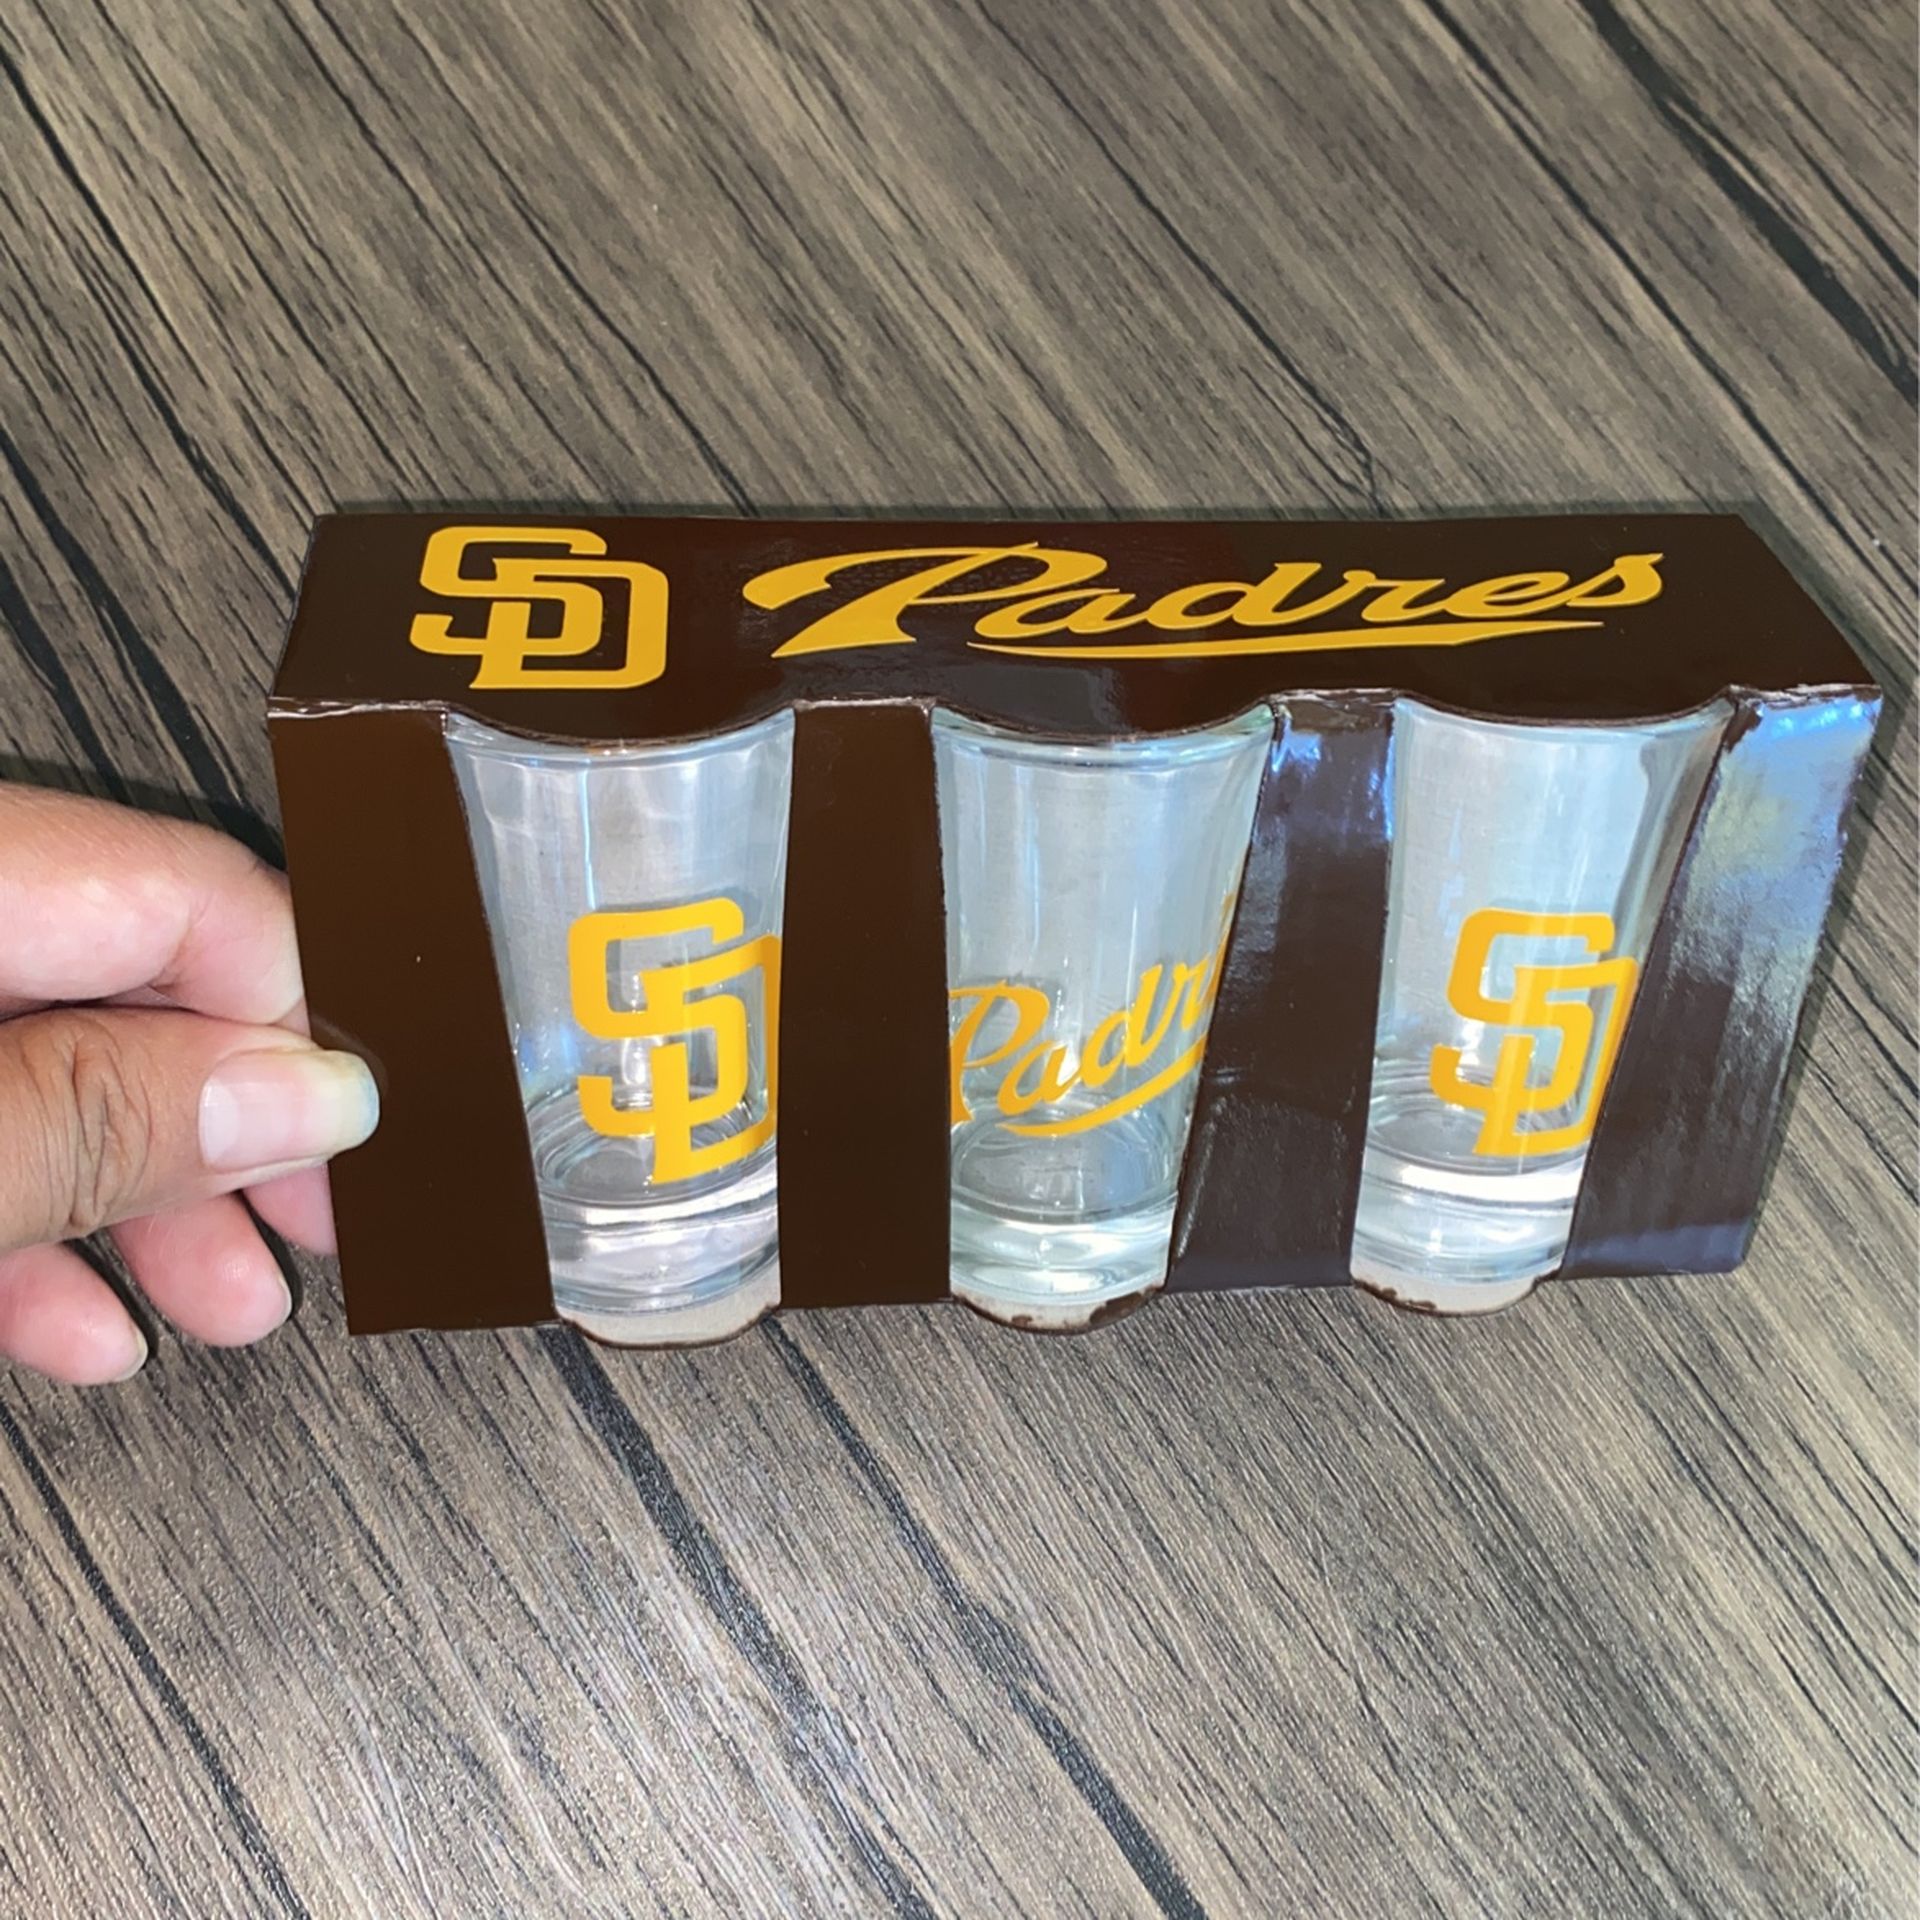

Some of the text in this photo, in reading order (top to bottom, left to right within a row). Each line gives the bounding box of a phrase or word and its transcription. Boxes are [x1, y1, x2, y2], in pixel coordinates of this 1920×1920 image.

[409, 526, 1663, 690] SD Padres
[948, 930, 1228, 1138] Padr
